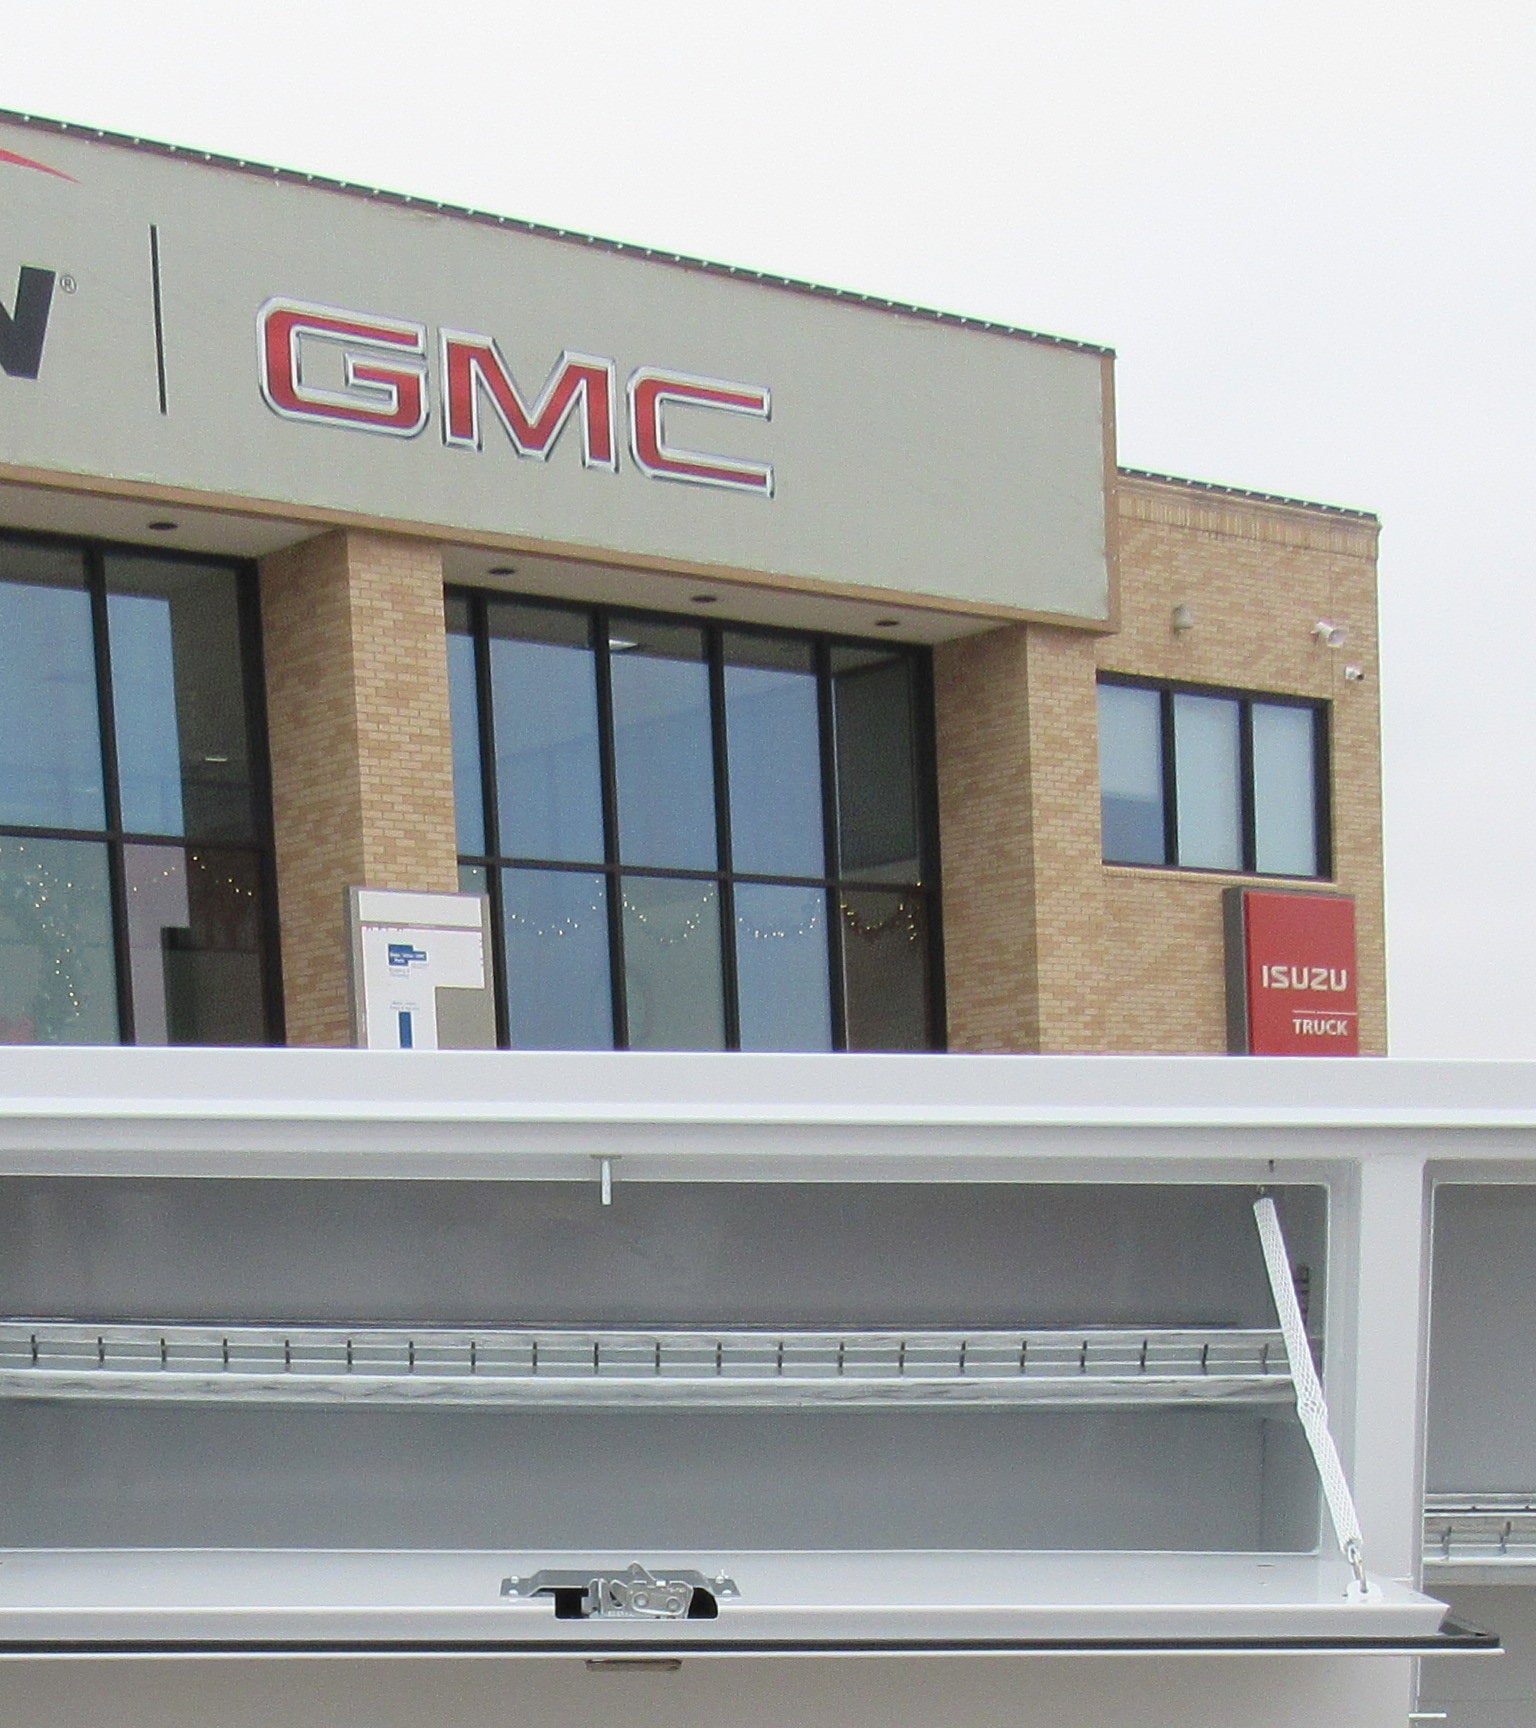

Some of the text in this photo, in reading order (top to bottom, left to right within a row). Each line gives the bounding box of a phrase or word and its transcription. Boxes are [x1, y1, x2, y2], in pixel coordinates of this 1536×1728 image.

[255, 296, 775, 499] GMC
[1262, 965, 1348, 991] ISUZU
[1292, 1018, 1348, 1036] TRUCK
